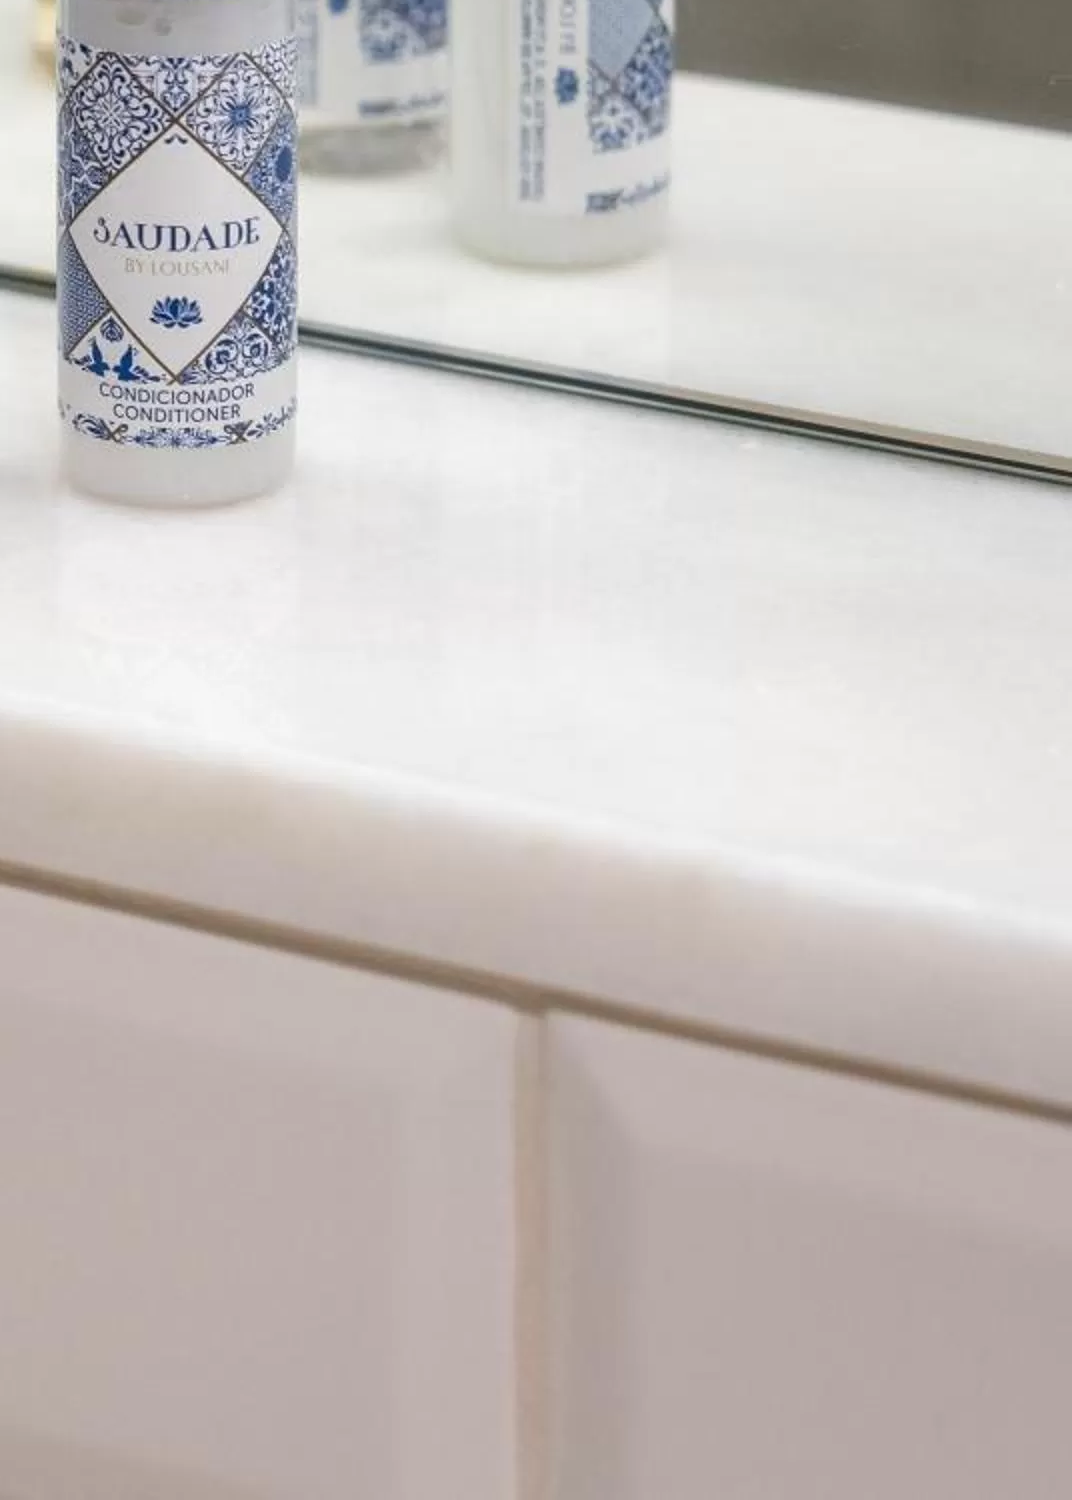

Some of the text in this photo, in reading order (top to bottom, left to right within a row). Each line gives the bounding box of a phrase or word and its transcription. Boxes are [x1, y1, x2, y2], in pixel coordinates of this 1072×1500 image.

[93, 216, 260, 252] SAUDADE
[124, 257, 229, 277] BY LOUSANI
[99, 382, 255, 405] CONDICIONADOR
[113, 403, 241, 423] CONDITIONER
